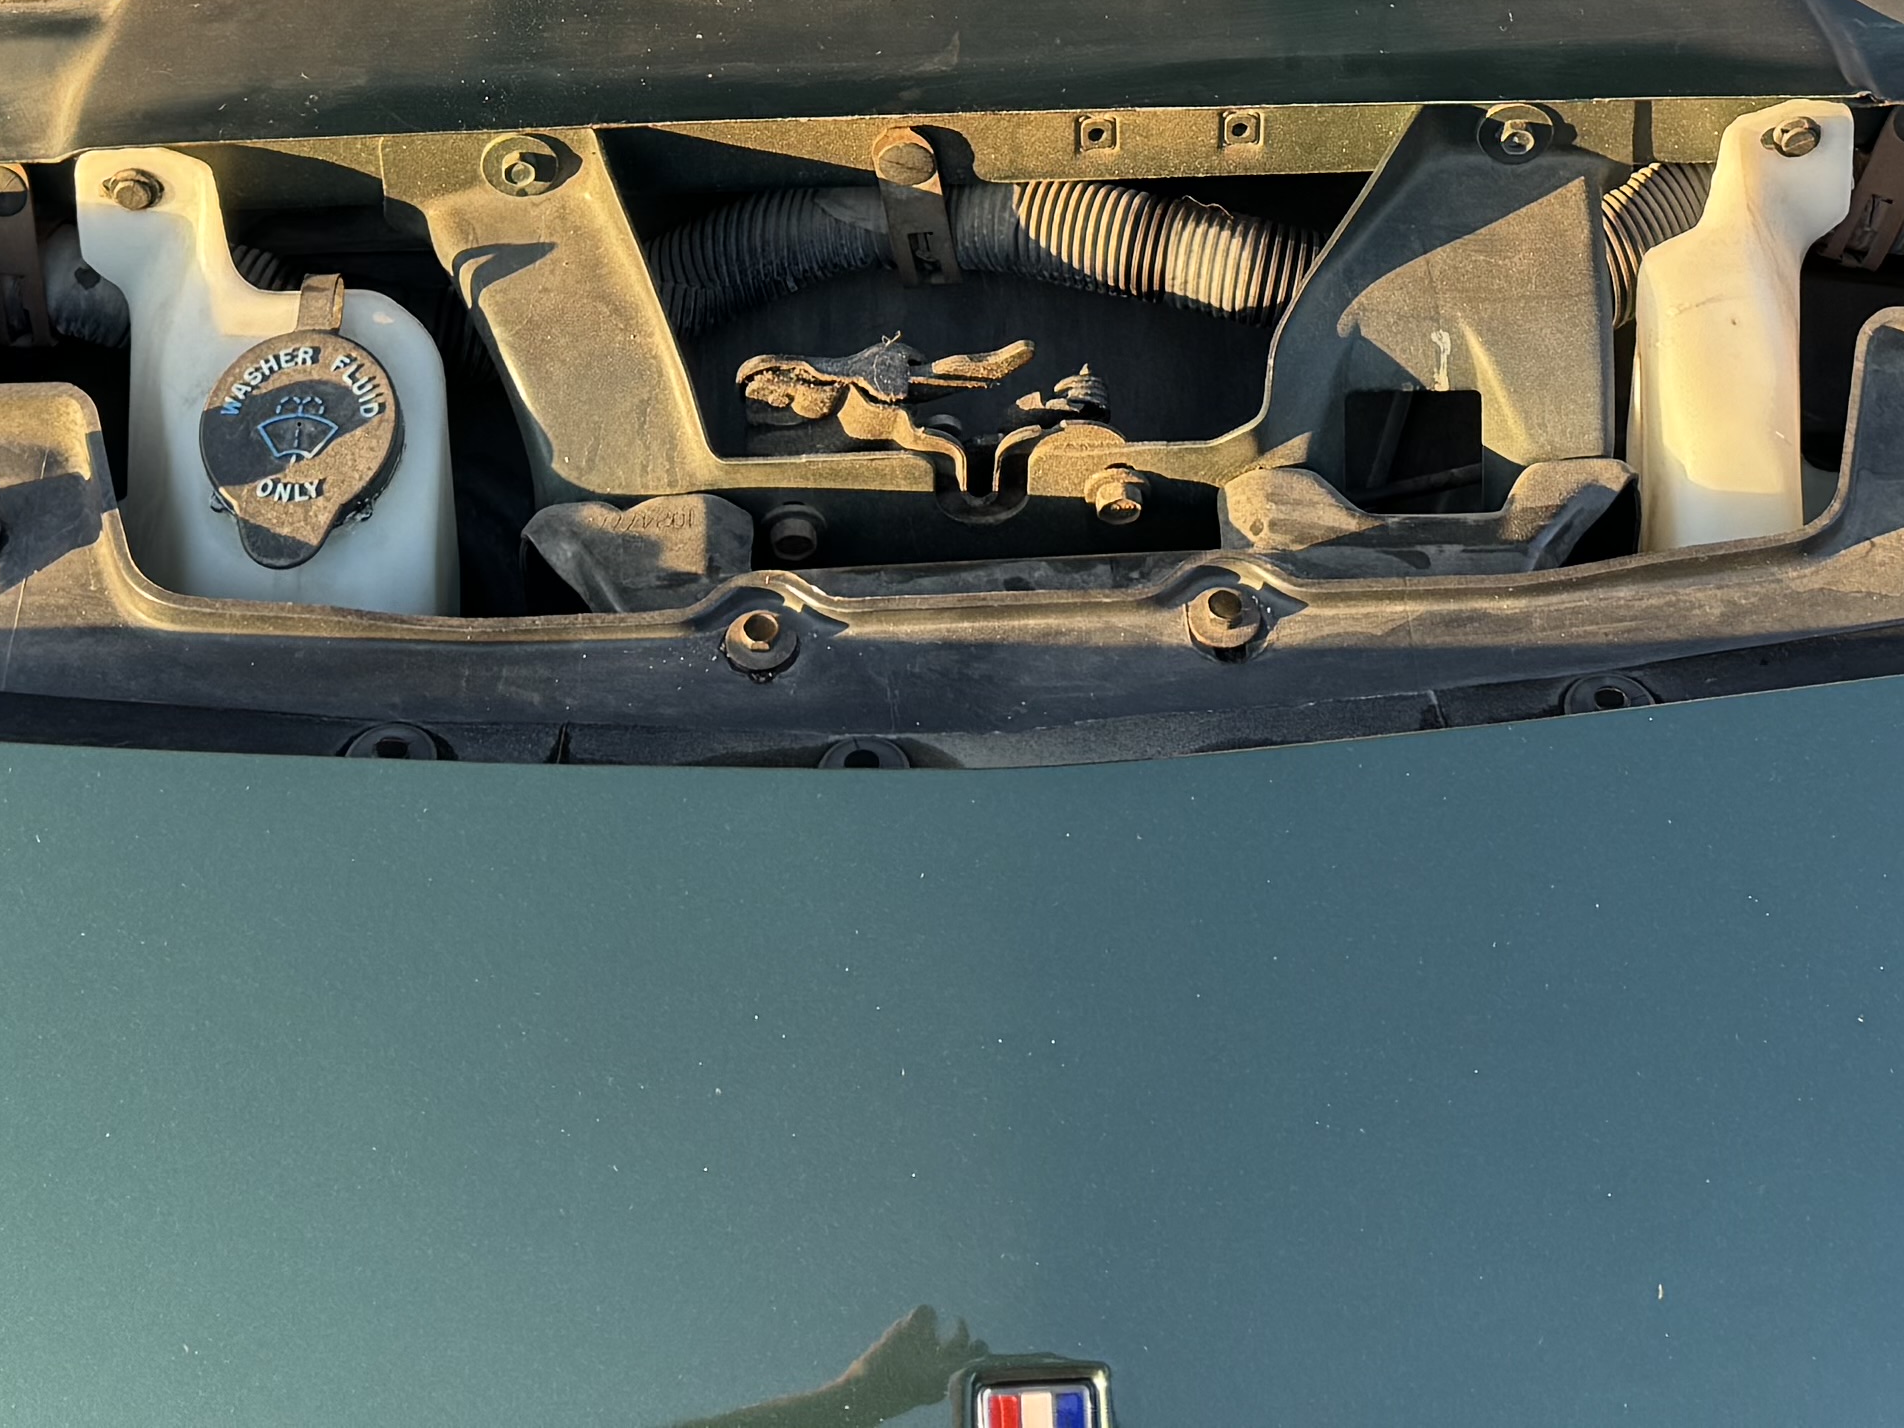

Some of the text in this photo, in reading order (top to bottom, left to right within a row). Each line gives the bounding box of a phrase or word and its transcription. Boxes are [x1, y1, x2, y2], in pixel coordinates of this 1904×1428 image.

[221, 346, 379, 418] WASHER FLUID
[256, 477, 320, 503] ONLY
